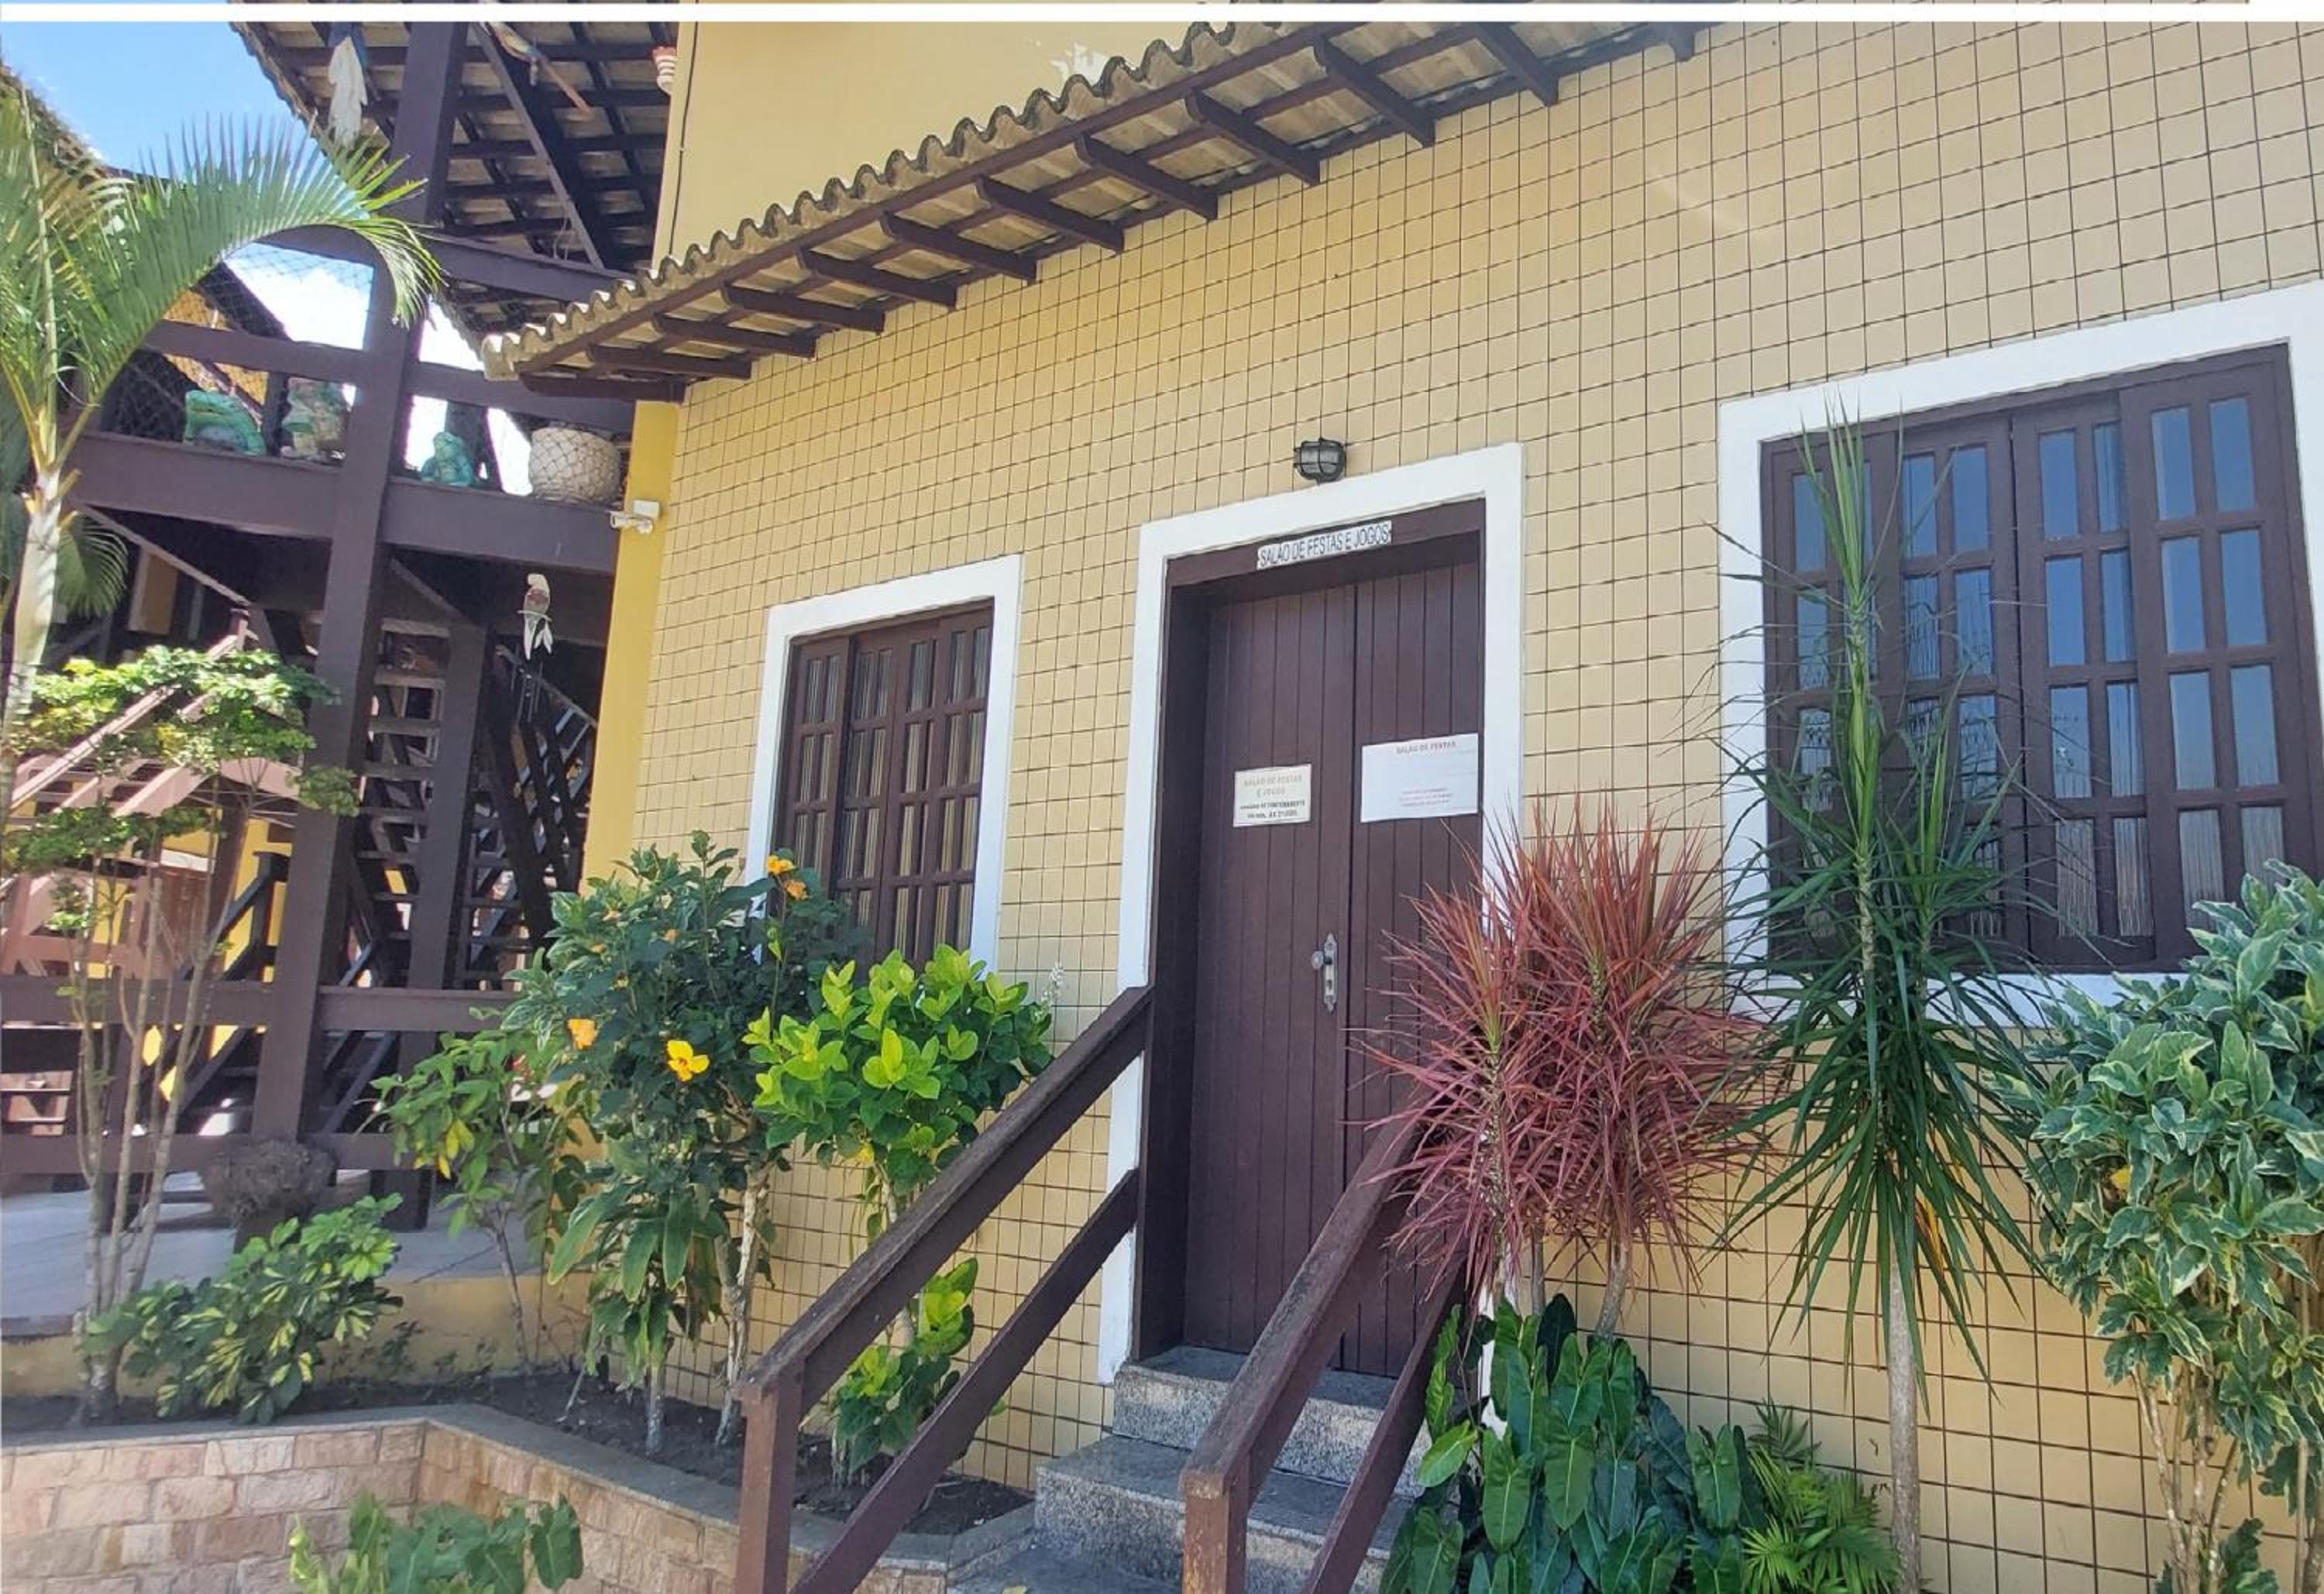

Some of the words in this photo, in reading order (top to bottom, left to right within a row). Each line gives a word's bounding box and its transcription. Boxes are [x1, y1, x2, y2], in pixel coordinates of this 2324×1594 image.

[1292, 541, 1305, 560] DE
[1308, 533, 1342, 555] FESTAS
[1345, 531, 1352, 550] E
[1355, 524, 1389, 547] JOGOS
